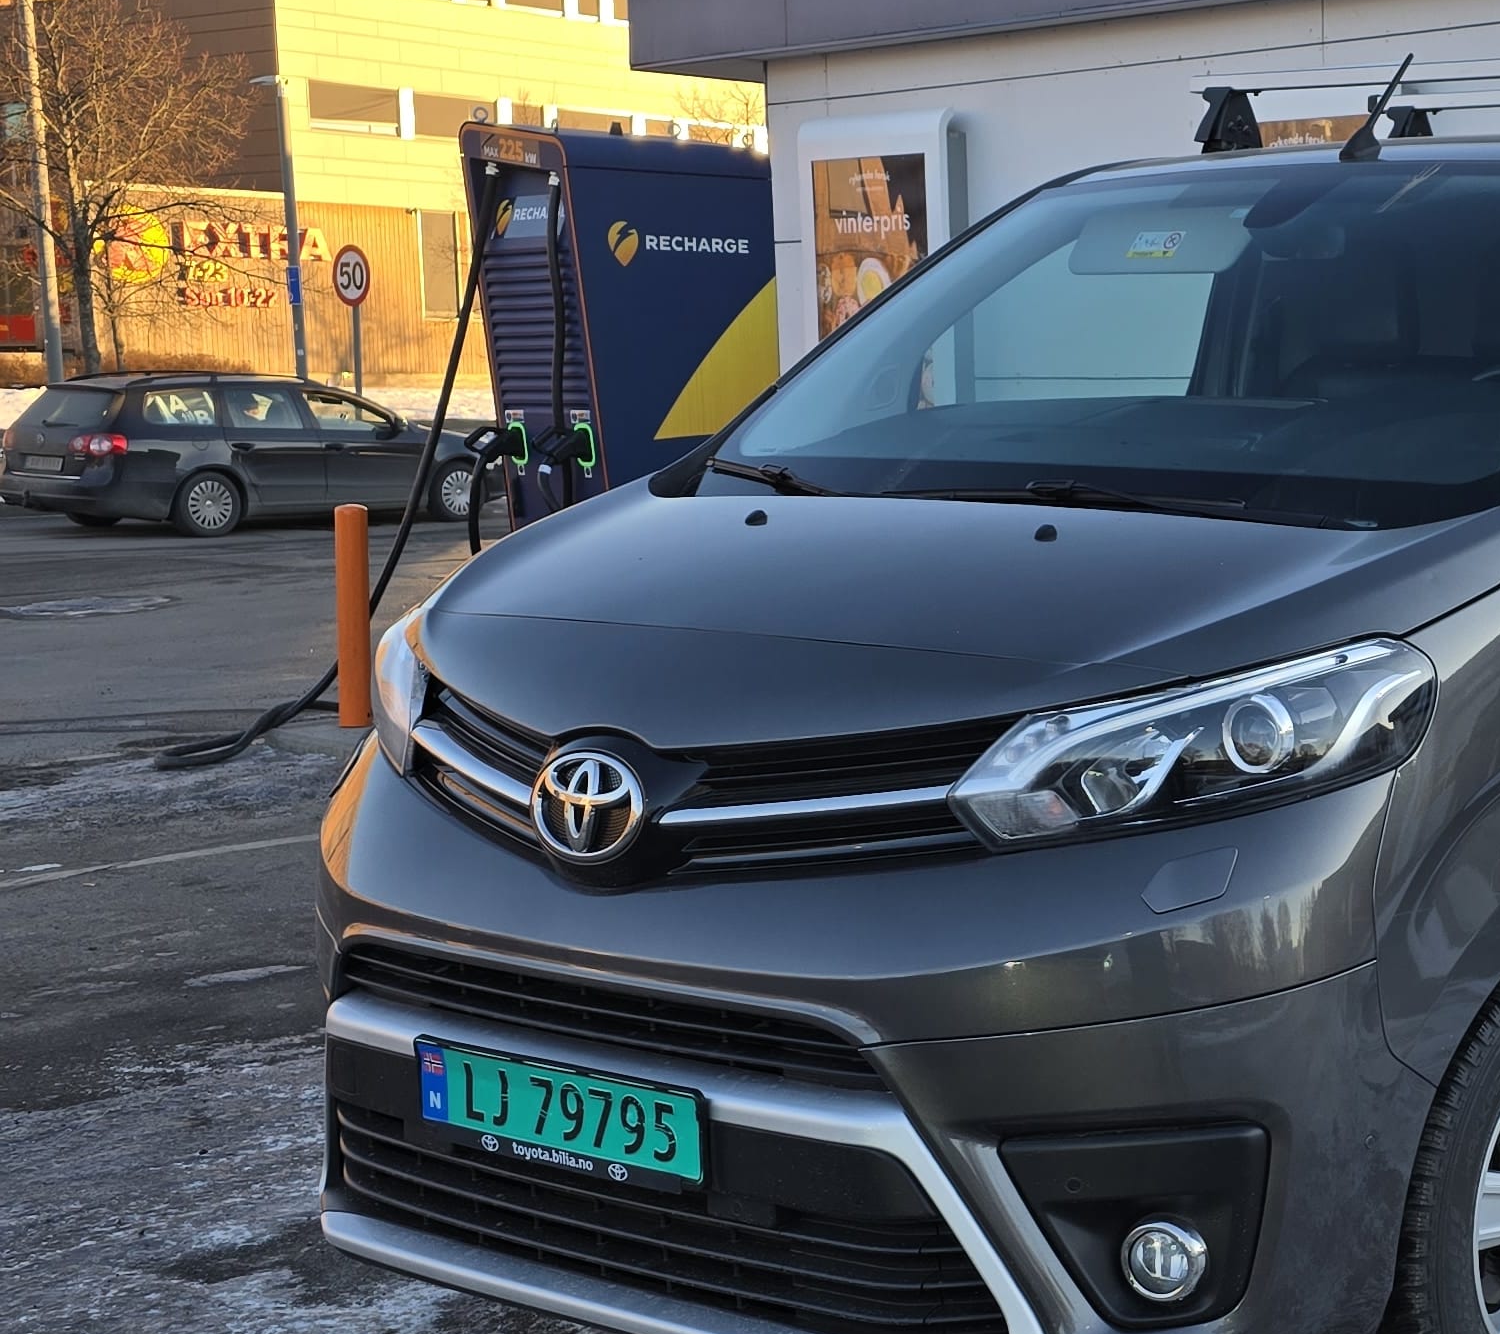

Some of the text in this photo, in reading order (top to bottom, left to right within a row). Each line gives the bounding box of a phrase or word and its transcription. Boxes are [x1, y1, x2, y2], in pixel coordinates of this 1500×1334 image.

[483, 145, 499, 158] MAX
[498, 138, 524, 162] 225
[834, 210, 911, 240] vinterpris
[645, 234, 750, 254] RECHARGE
[340, 261, 364, 290] 50
[429, 1090, 442, 1110] N
[463, 1061, 678, 1163] LJ 79795
[511, 1141, 594, 1172] toyota.bilia.no
